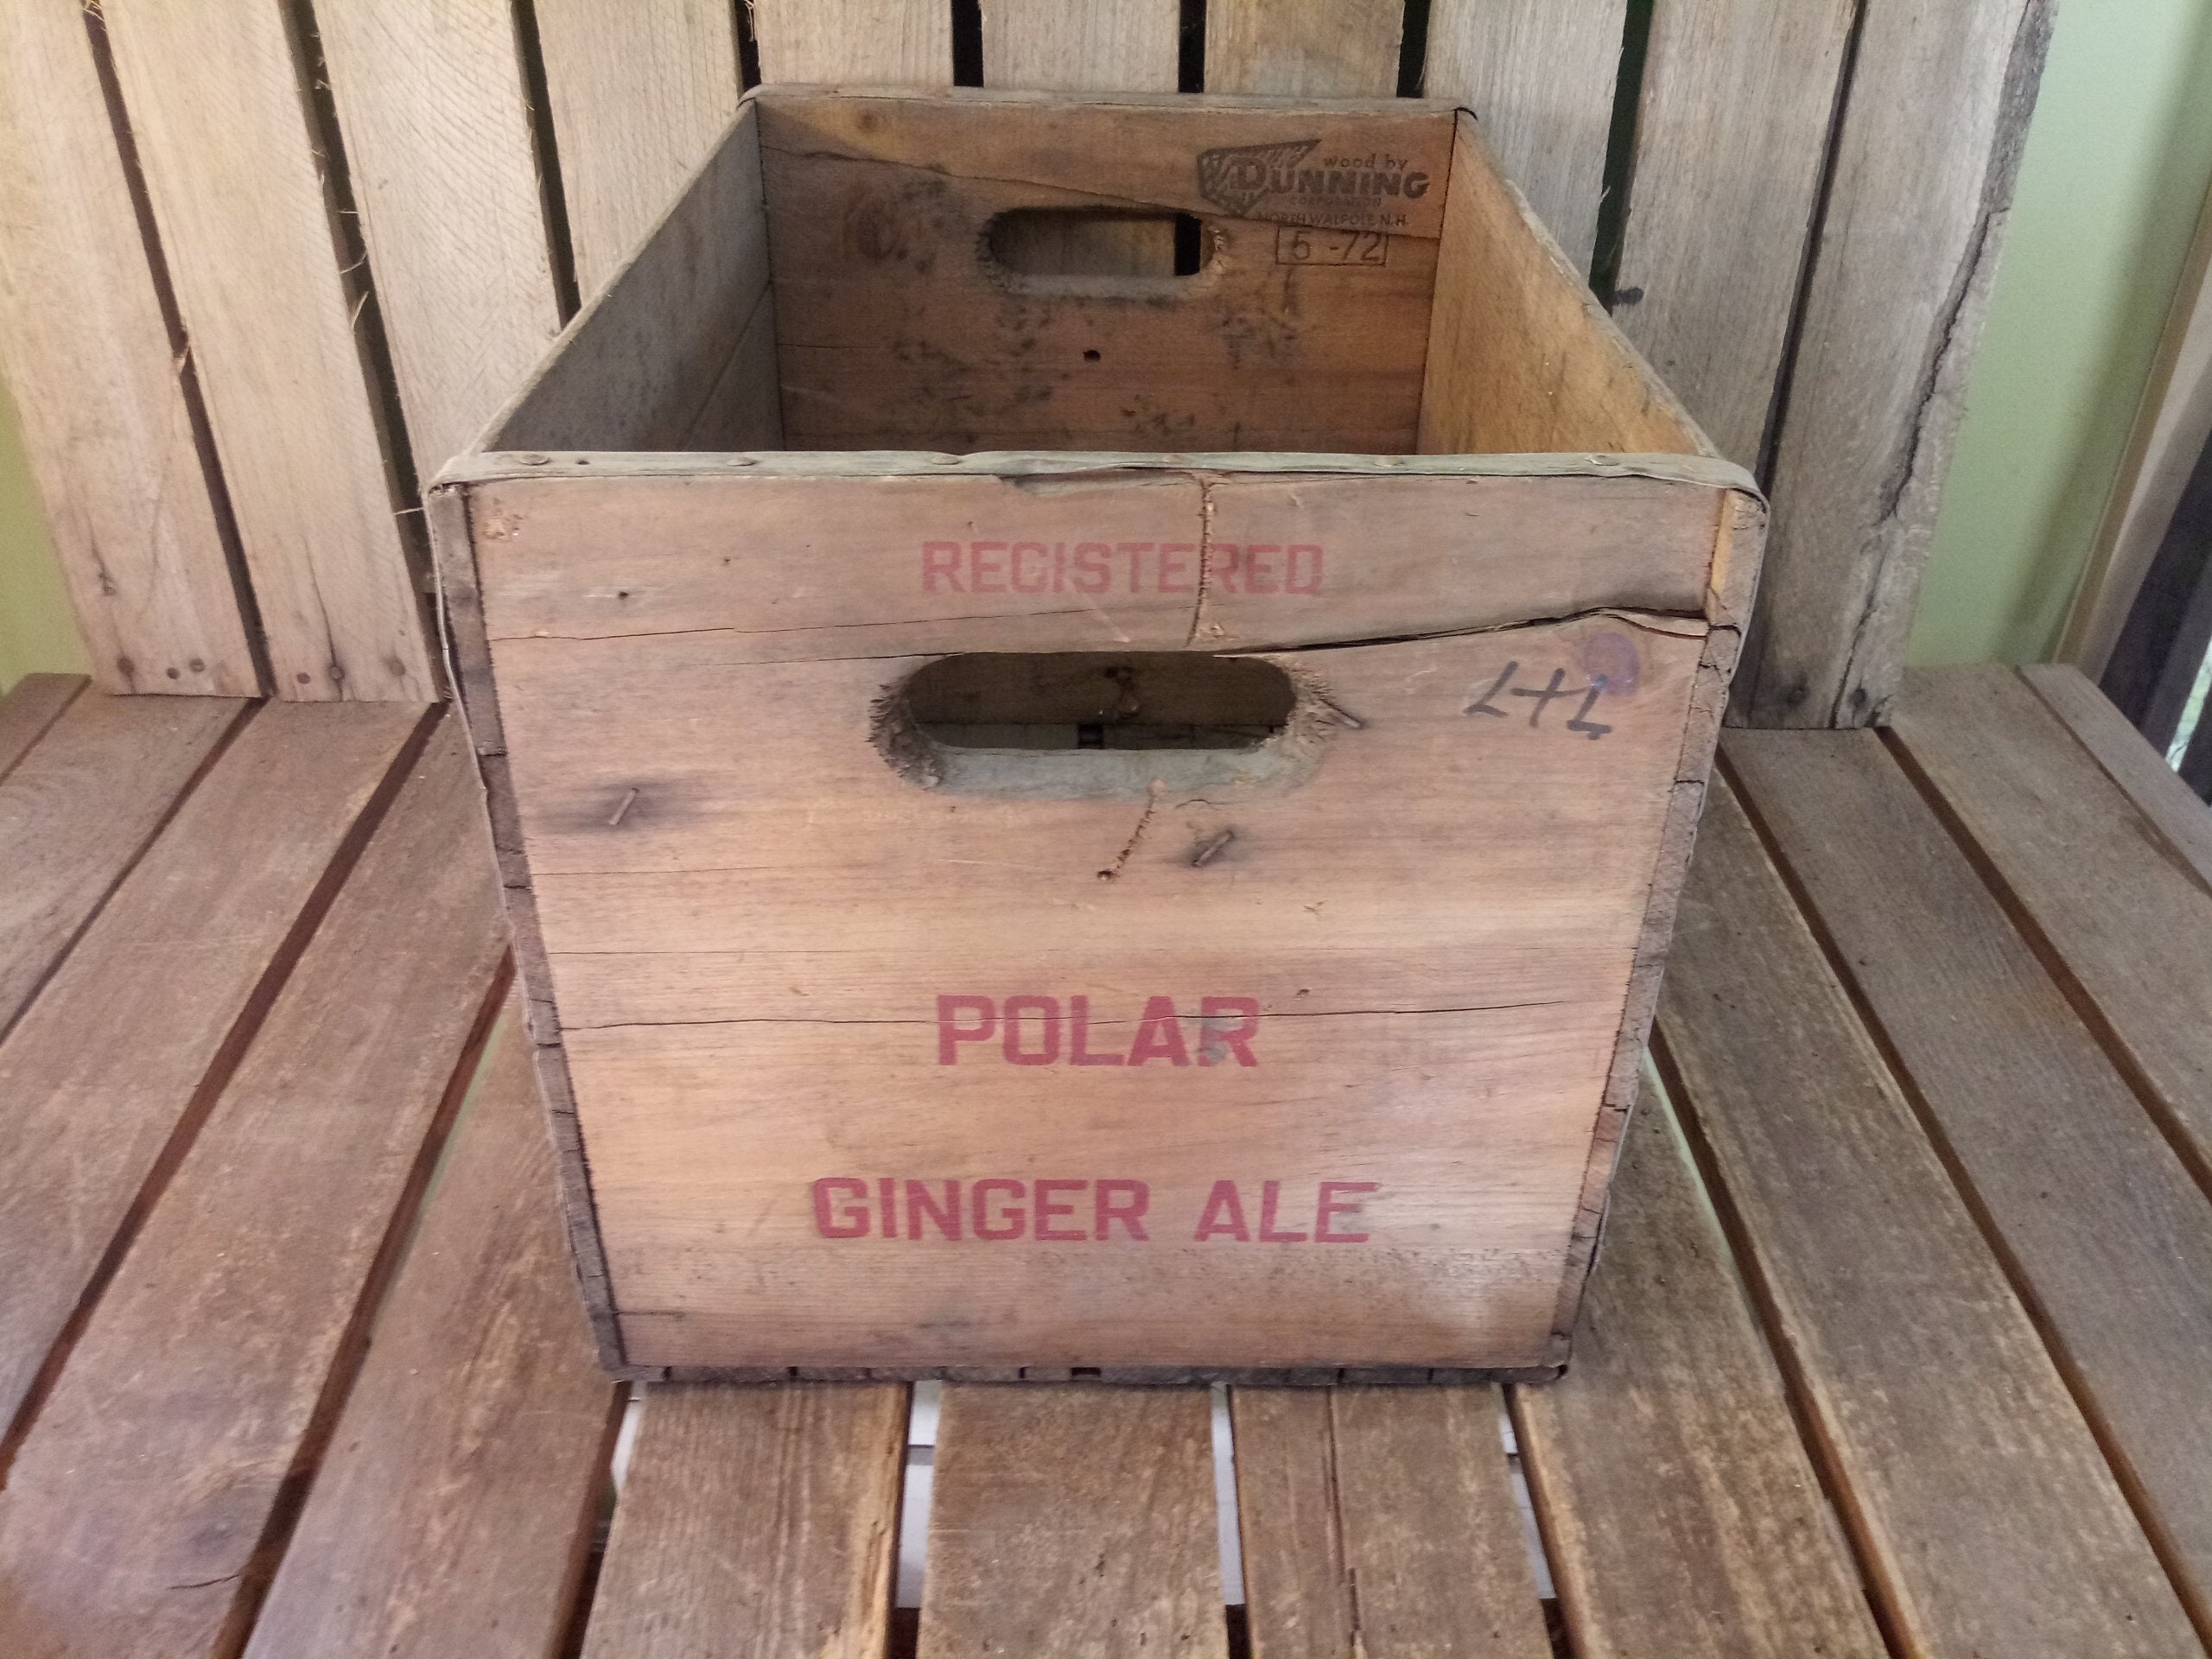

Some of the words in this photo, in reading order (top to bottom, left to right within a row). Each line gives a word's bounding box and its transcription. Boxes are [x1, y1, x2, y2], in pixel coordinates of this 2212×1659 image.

[1227, 158, 1430, 199] DUNNING
[1324, 154, 1376, 169] wood
[1385, 154, 1409, 171] by
[922, 540, 1325, 595] REGISTERED
[936, 994, 1261, 1068] POLAR
[812, 1176, 1150, 1242] GINGER
[1193, 1179, 1382, 1243] ALE
